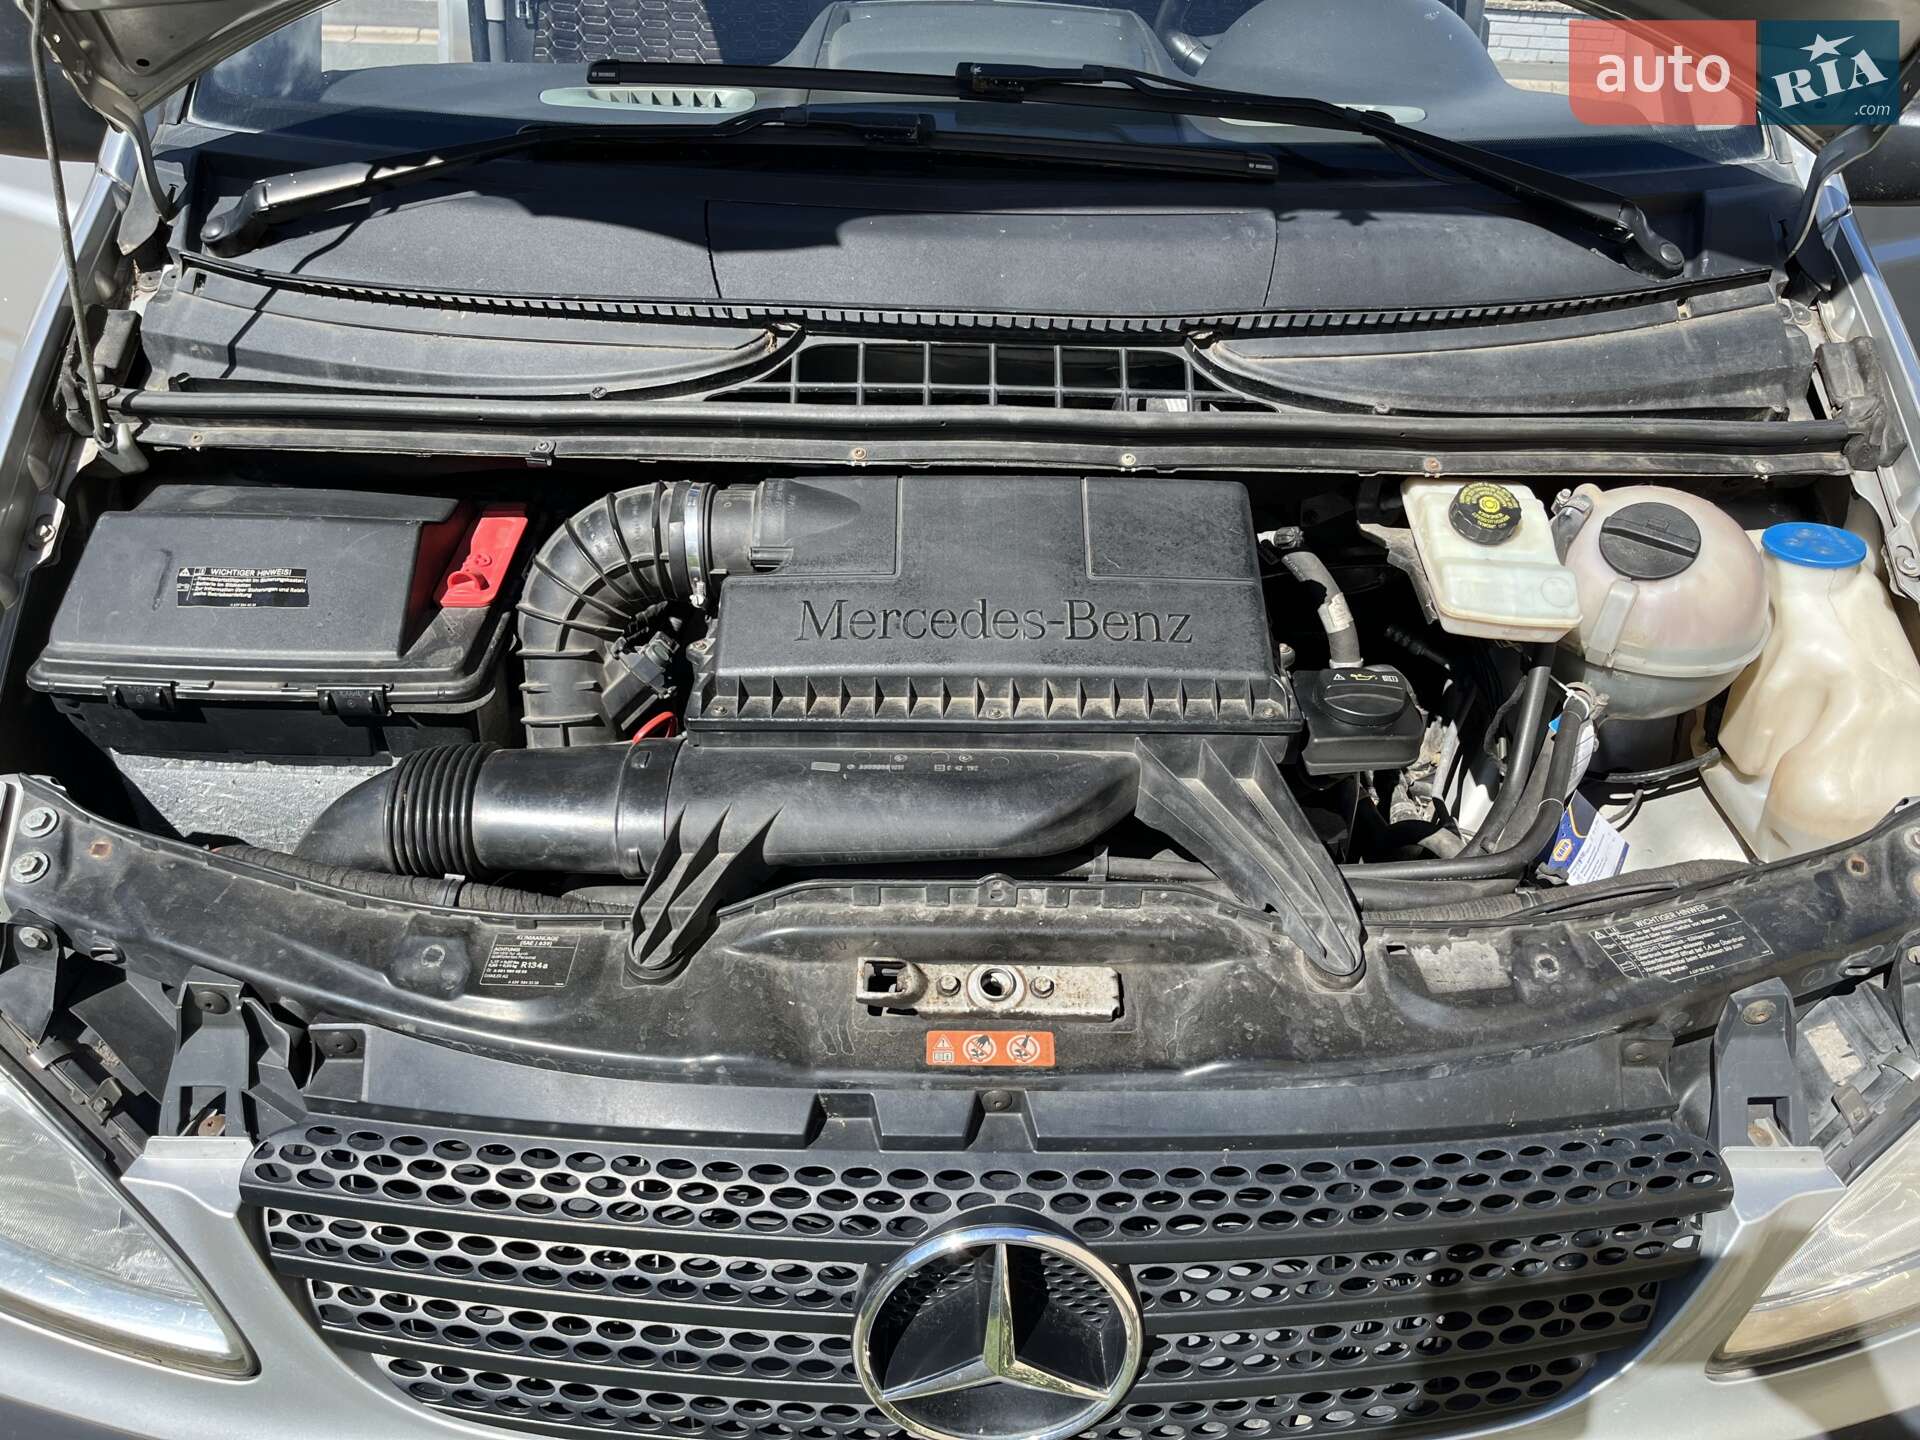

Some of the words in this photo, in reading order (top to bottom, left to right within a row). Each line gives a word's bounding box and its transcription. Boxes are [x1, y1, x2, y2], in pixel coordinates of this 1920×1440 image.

[793, 598, 1192, 644] Mercedes-Benz
[1634, 911, 1677, 928] WICHTIGER
[1677, 904, 1708, 917] HINWEIS
